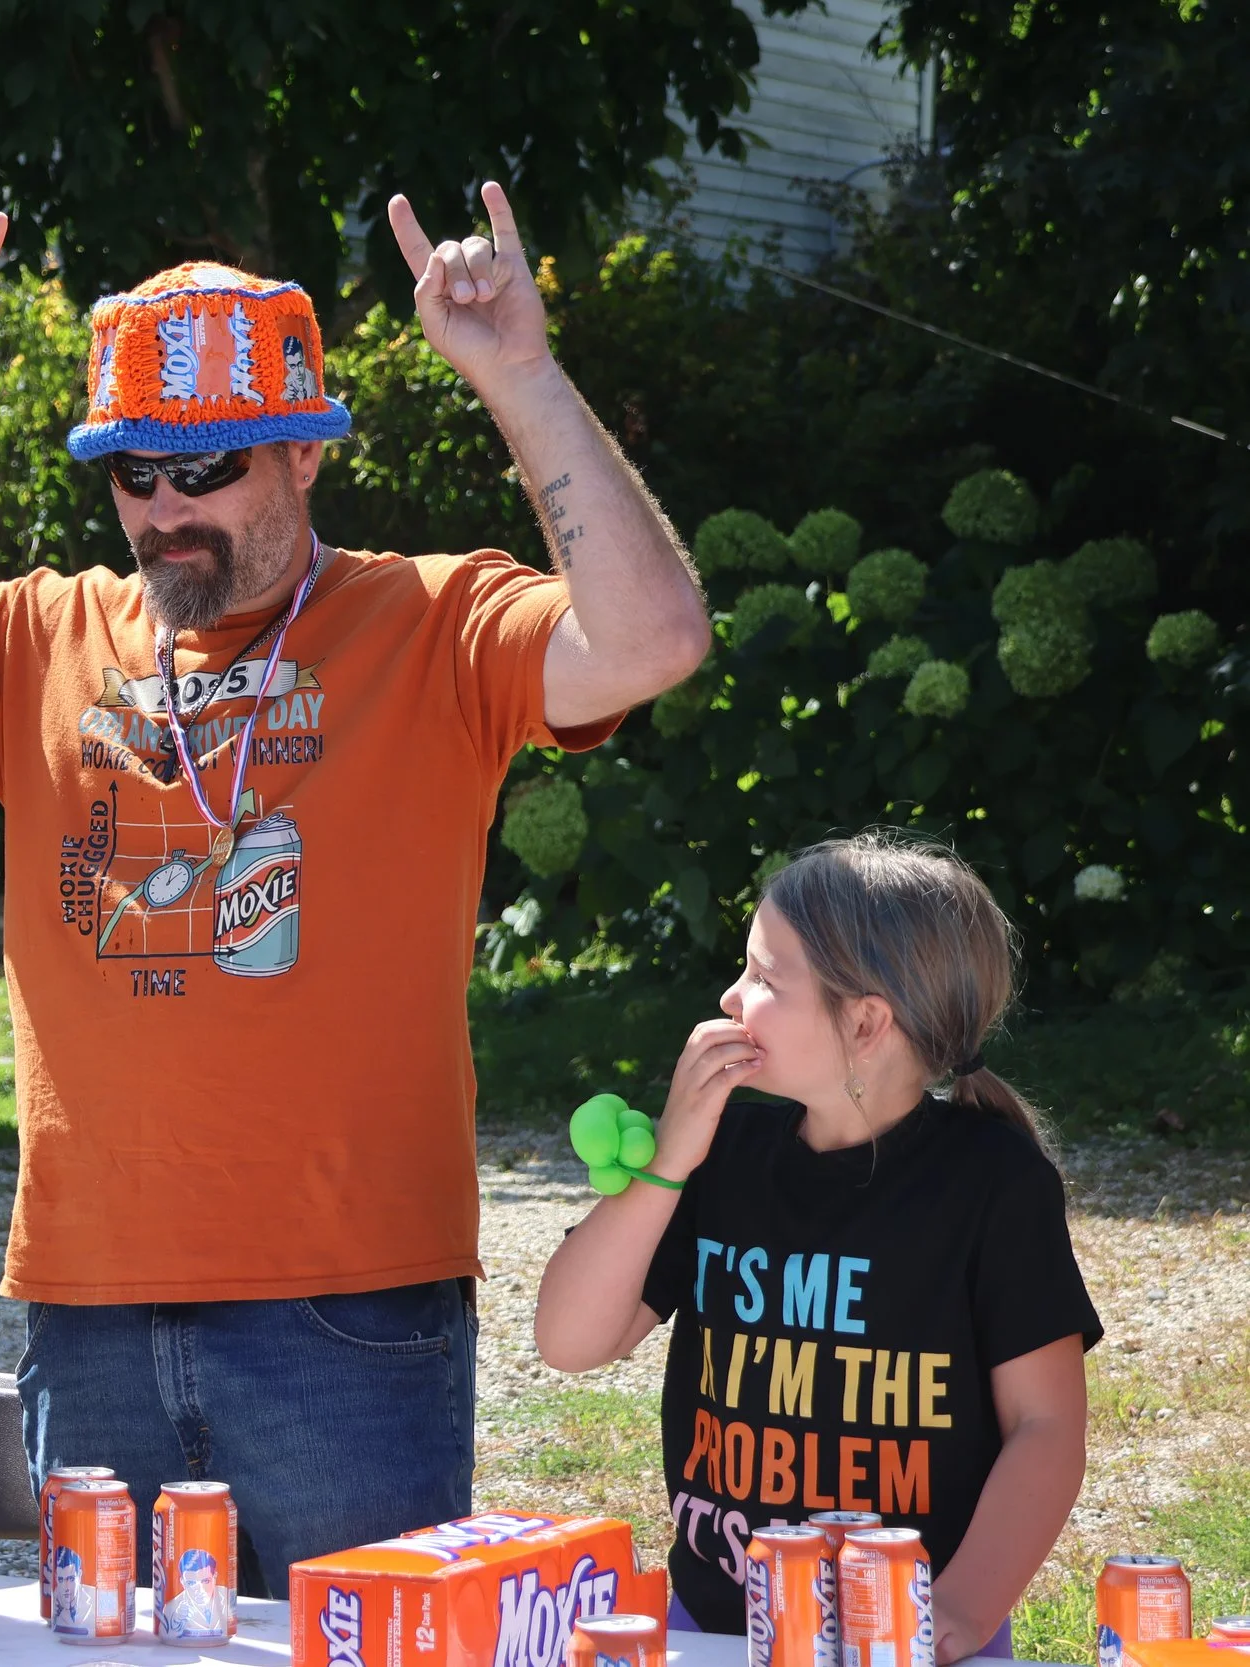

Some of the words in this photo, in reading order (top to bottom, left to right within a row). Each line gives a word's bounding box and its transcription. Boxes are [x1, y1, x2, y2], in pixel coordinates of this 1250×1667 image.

[156, 665, 250, 707] 205
[188, 714, 261, 754] RIVE
[267, 693, 325, 731] DAY
[81, 740, 134, 770] MOXIE
[60, 834, 84, 924] MOXIE
[78, 800, 109, 936] CHUGGED
[215, 867, 301, 938] MOXIE
[130, 969, 187, 997] TIME
[694, 1237, 768, 1324] T'S
[782, 1253, 871, 1335] ME
[725, 1333, 818, 1419] I'M
[834, 1345, 952, 1429] THE
[683, 1407, 931, 1515] PROBLEM
[672, 1491, 750, 1587] IT'S
[422, 1592, 431, 1611] Pack
[862, 1569, 876, 1579] 140
[415, 1626, 435, 1652] 12
[422, 1611, 431, 1626] Can
